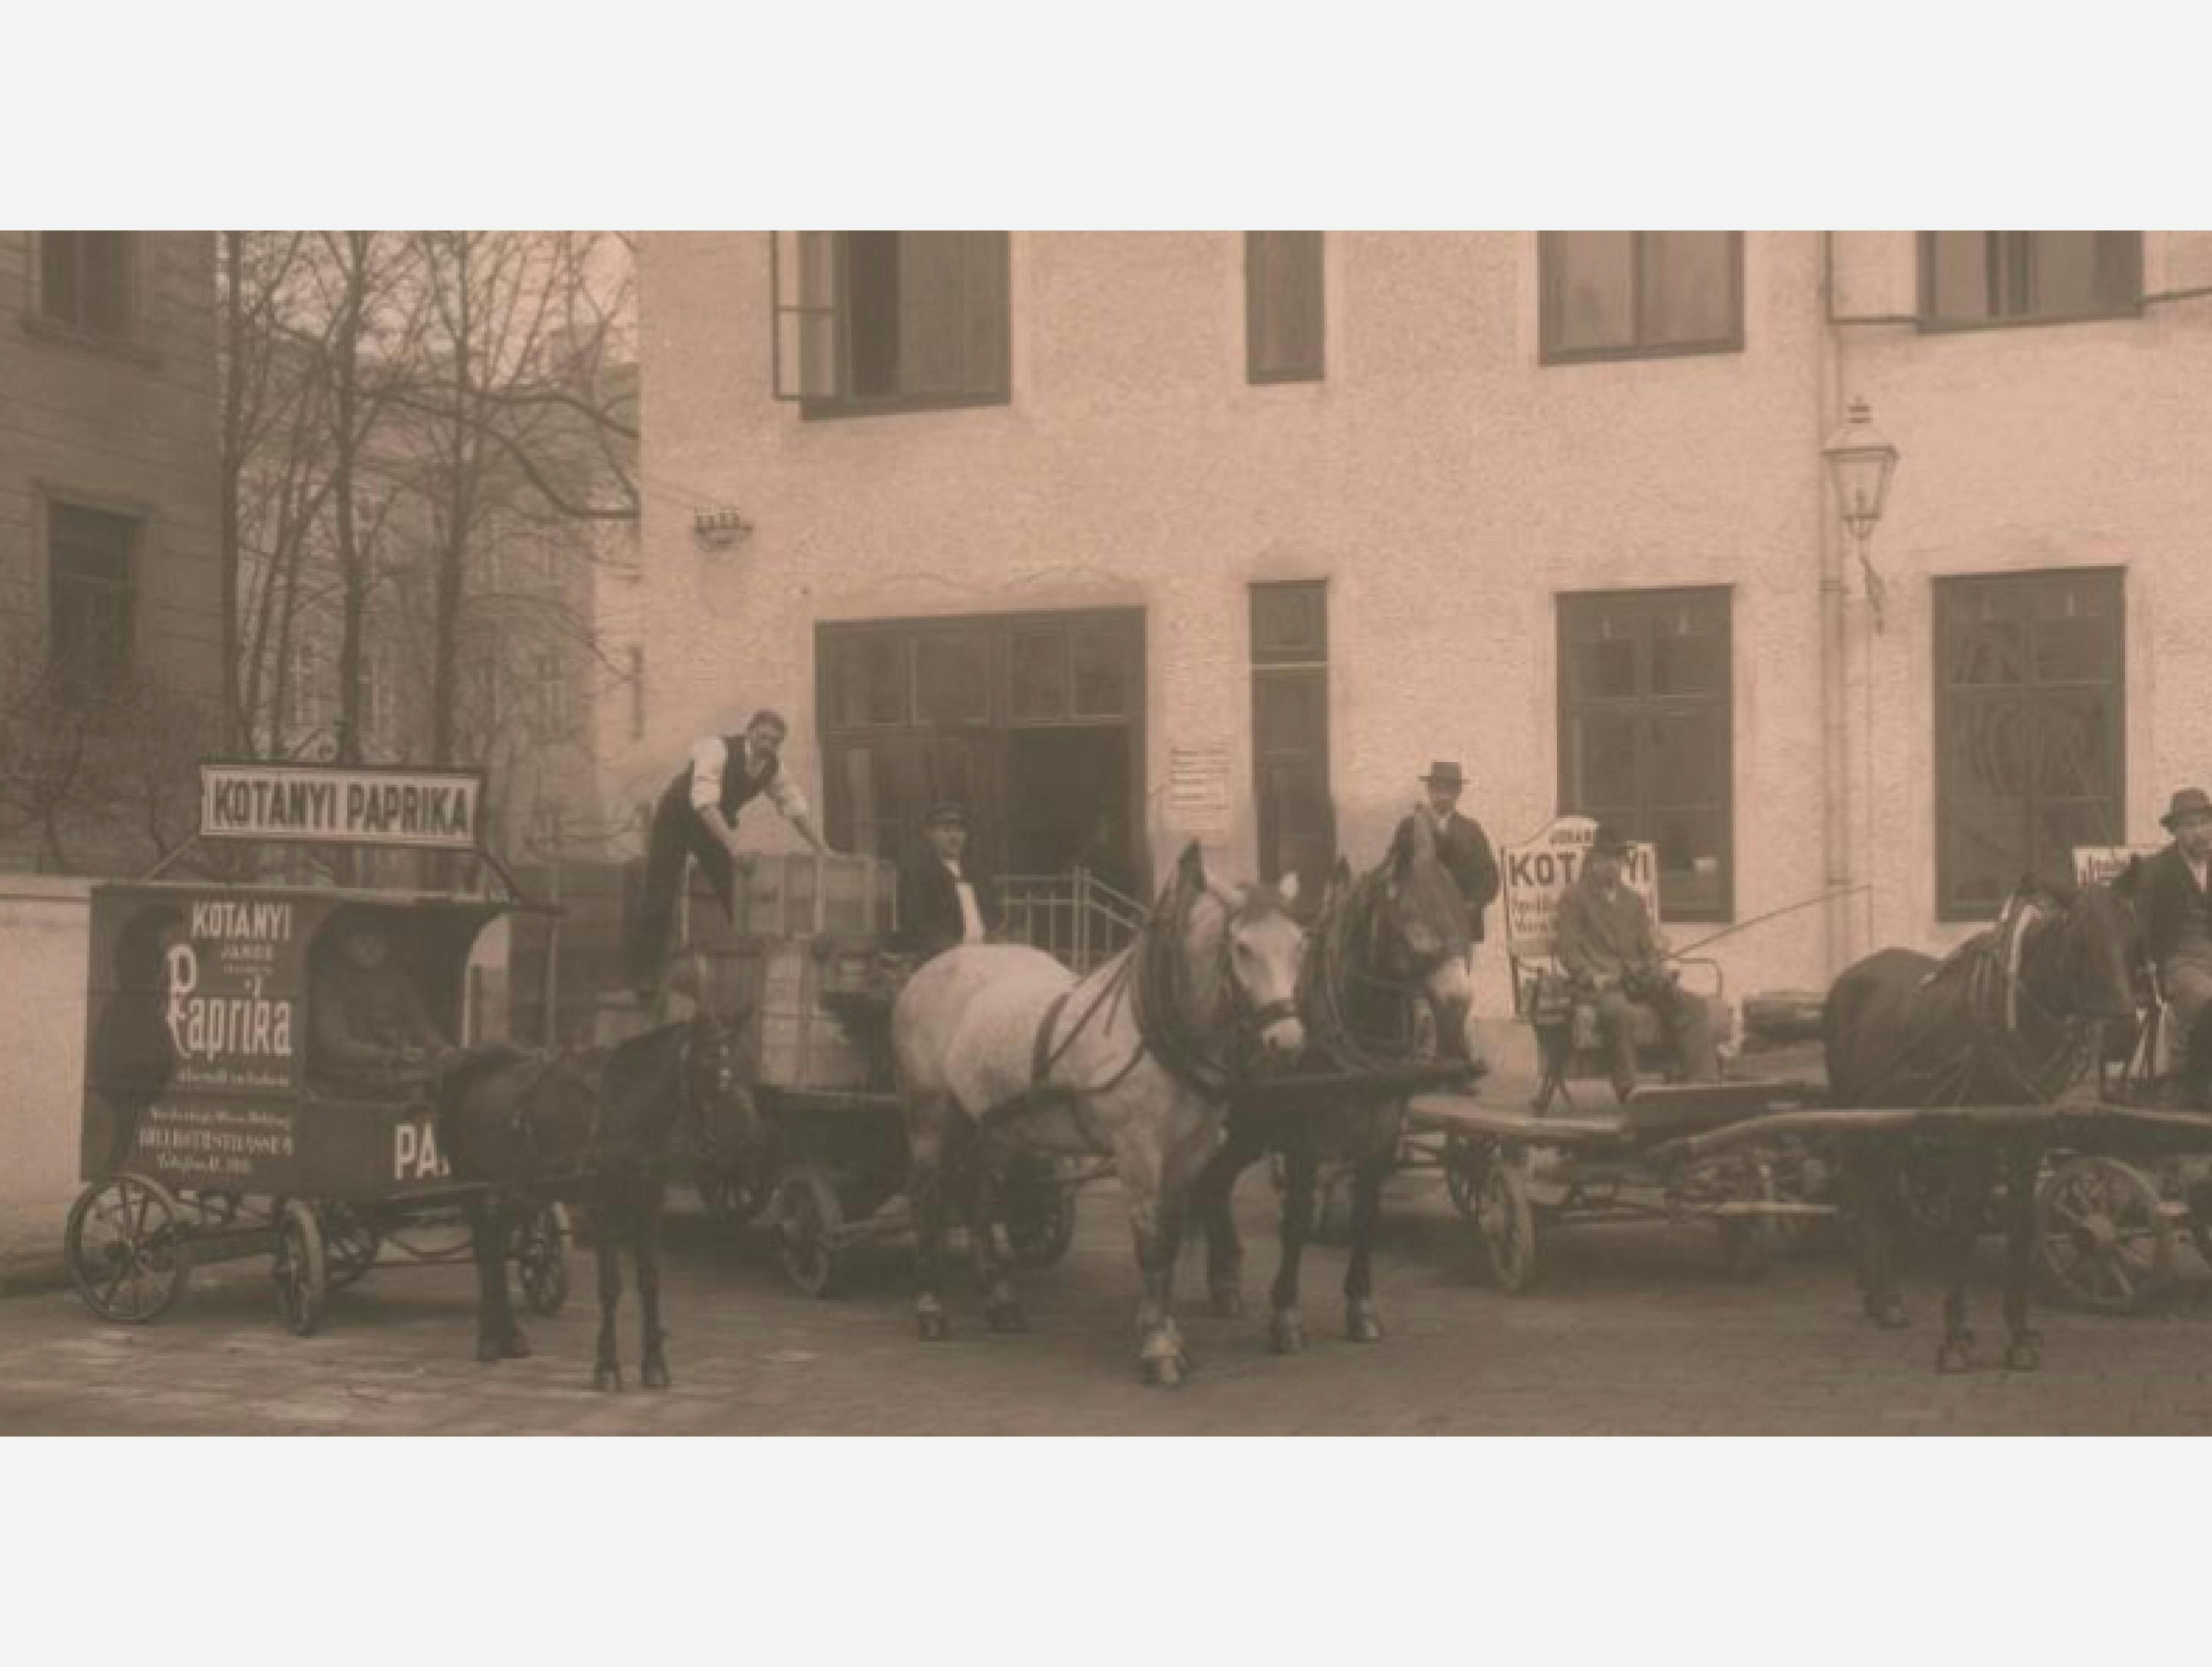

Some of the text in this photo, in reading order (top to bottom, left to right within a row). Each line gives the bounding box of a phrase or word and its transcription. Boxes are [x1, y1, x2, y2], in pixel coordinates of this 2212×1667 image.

[214, 778, 469, 836] KOTANYI PAPRIKA
[1508, 850, 1650, 887] KOTYI
[191, 900, 293, 941] KOTANYI
[165, 944, 293, 1062] Paprika
